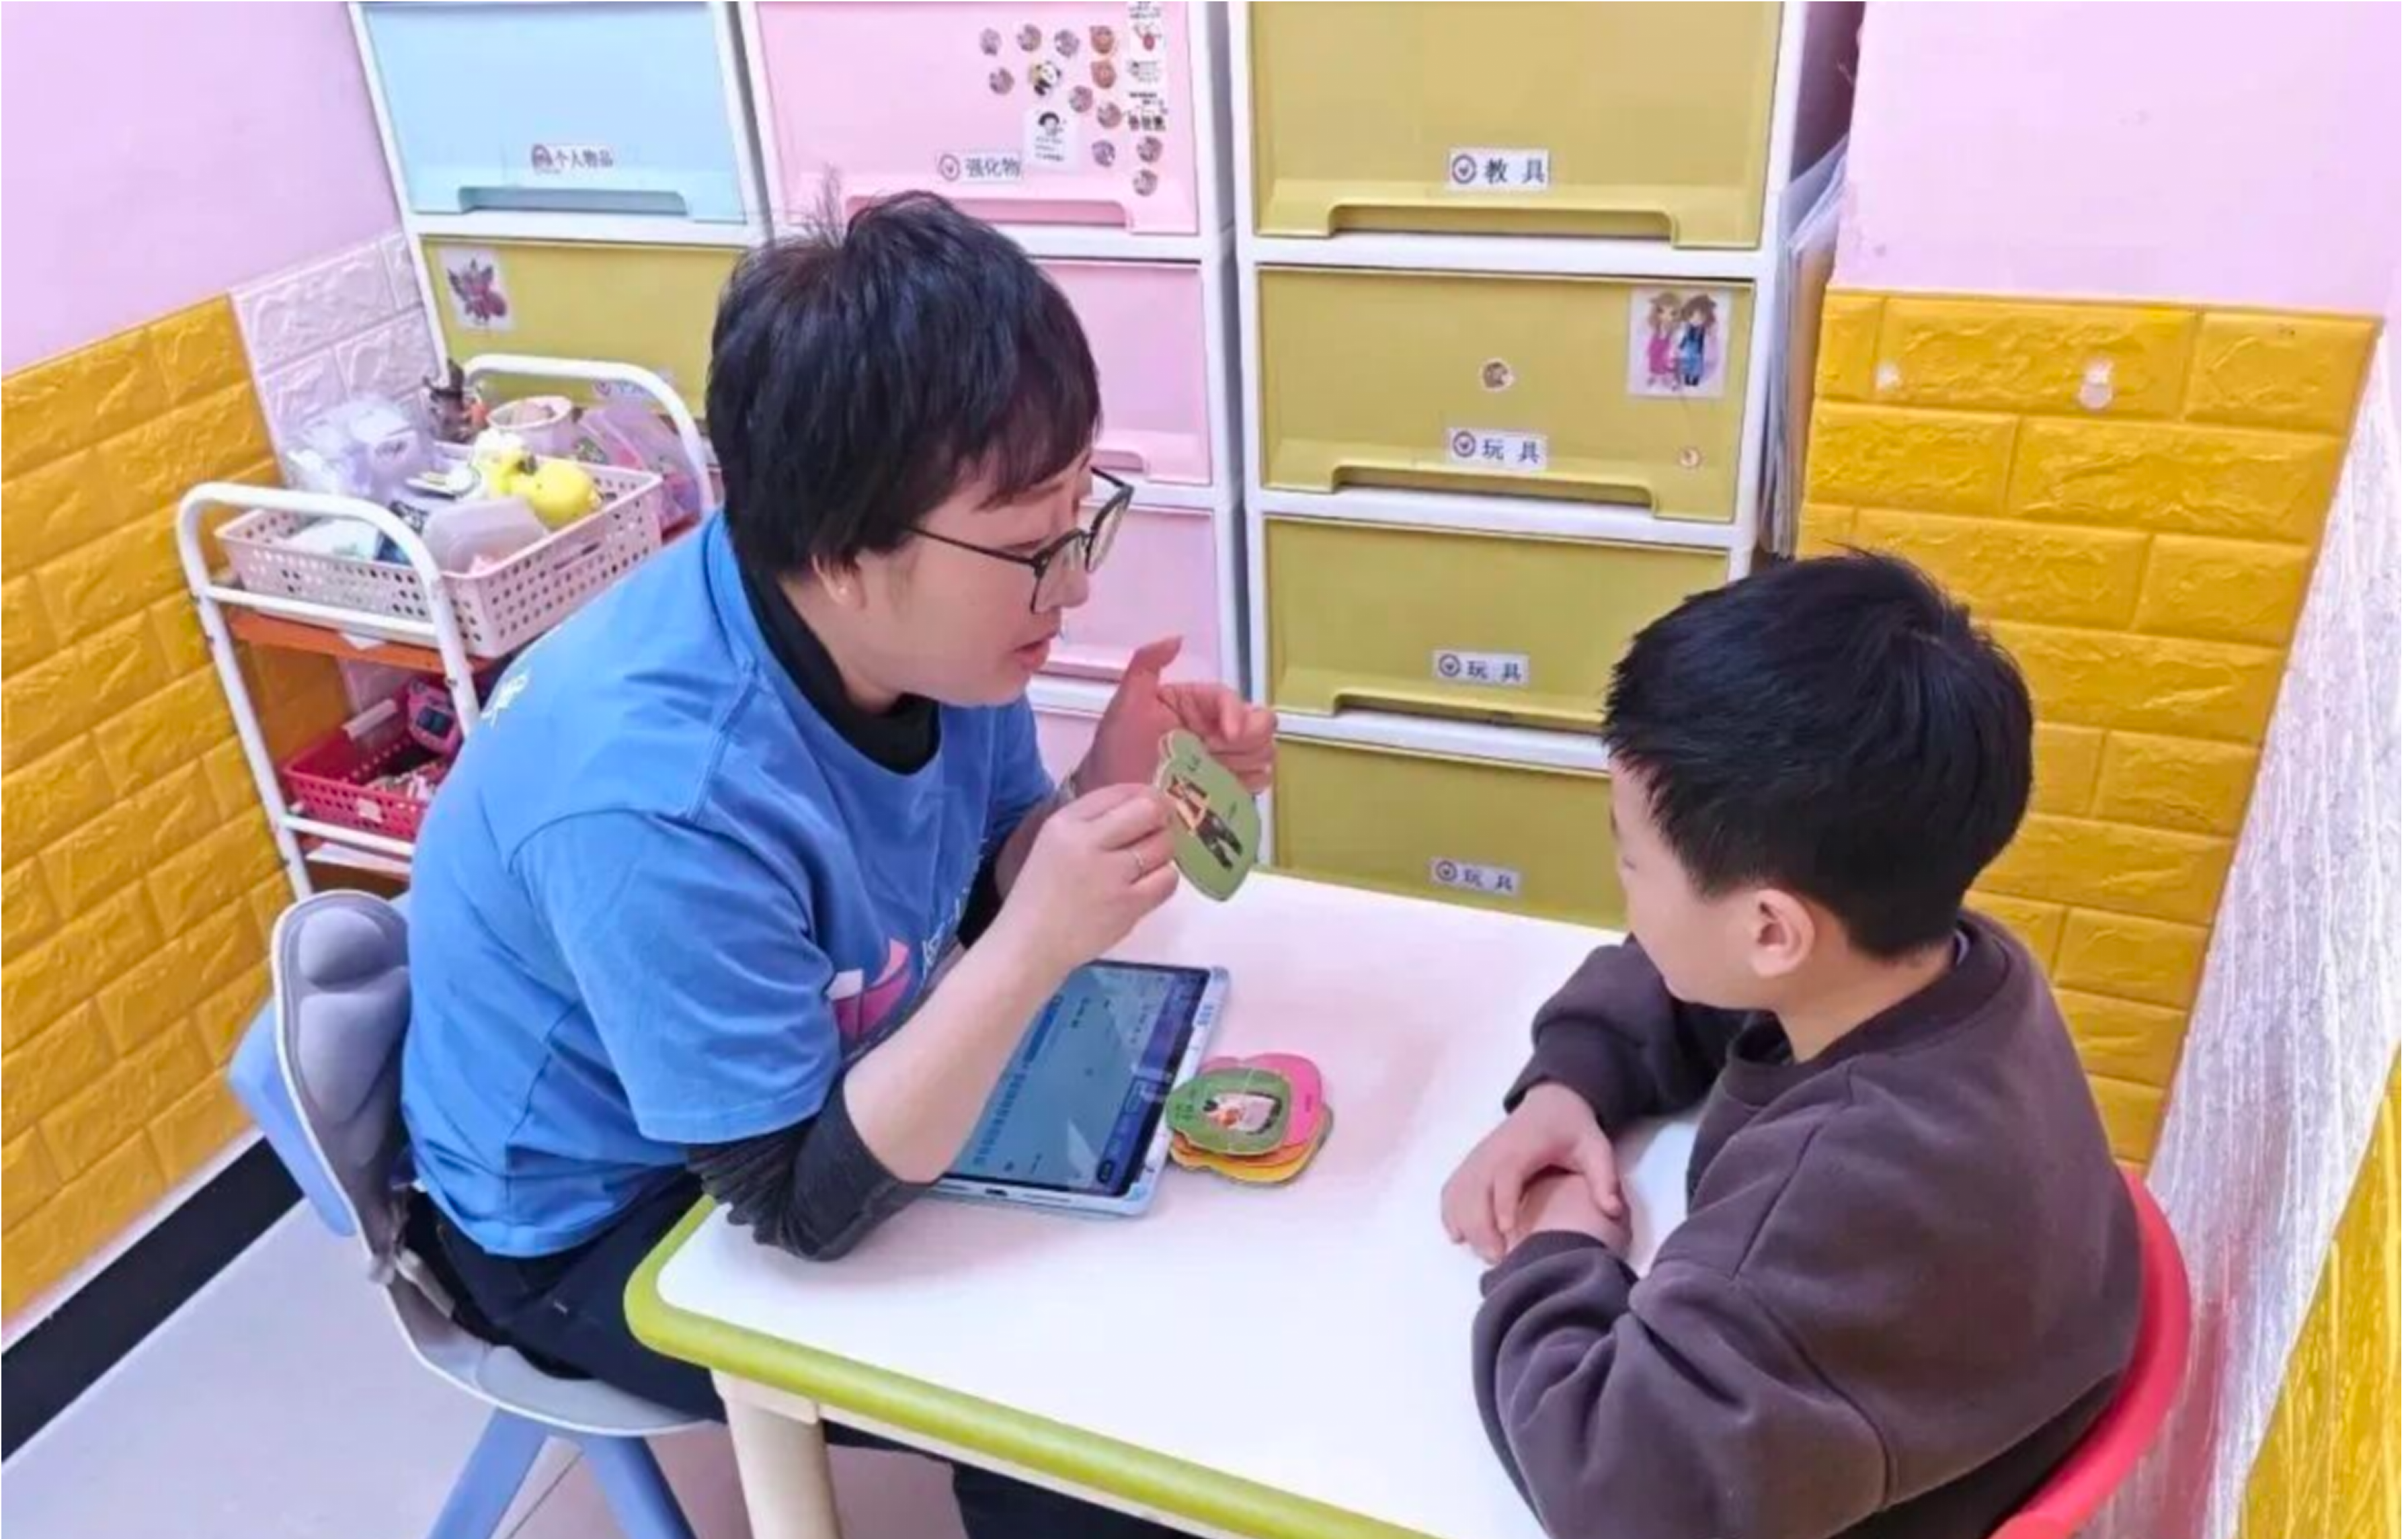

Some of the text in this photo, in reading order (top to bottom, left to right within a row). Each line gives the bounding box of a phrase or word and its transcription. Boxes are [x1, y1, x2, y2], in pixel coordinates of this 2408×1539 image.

[555, 148, 614, 168] 个人物品
[1485, 157, 1544, 184] 教具
[1482, 439, 1538, 464] 玩具
